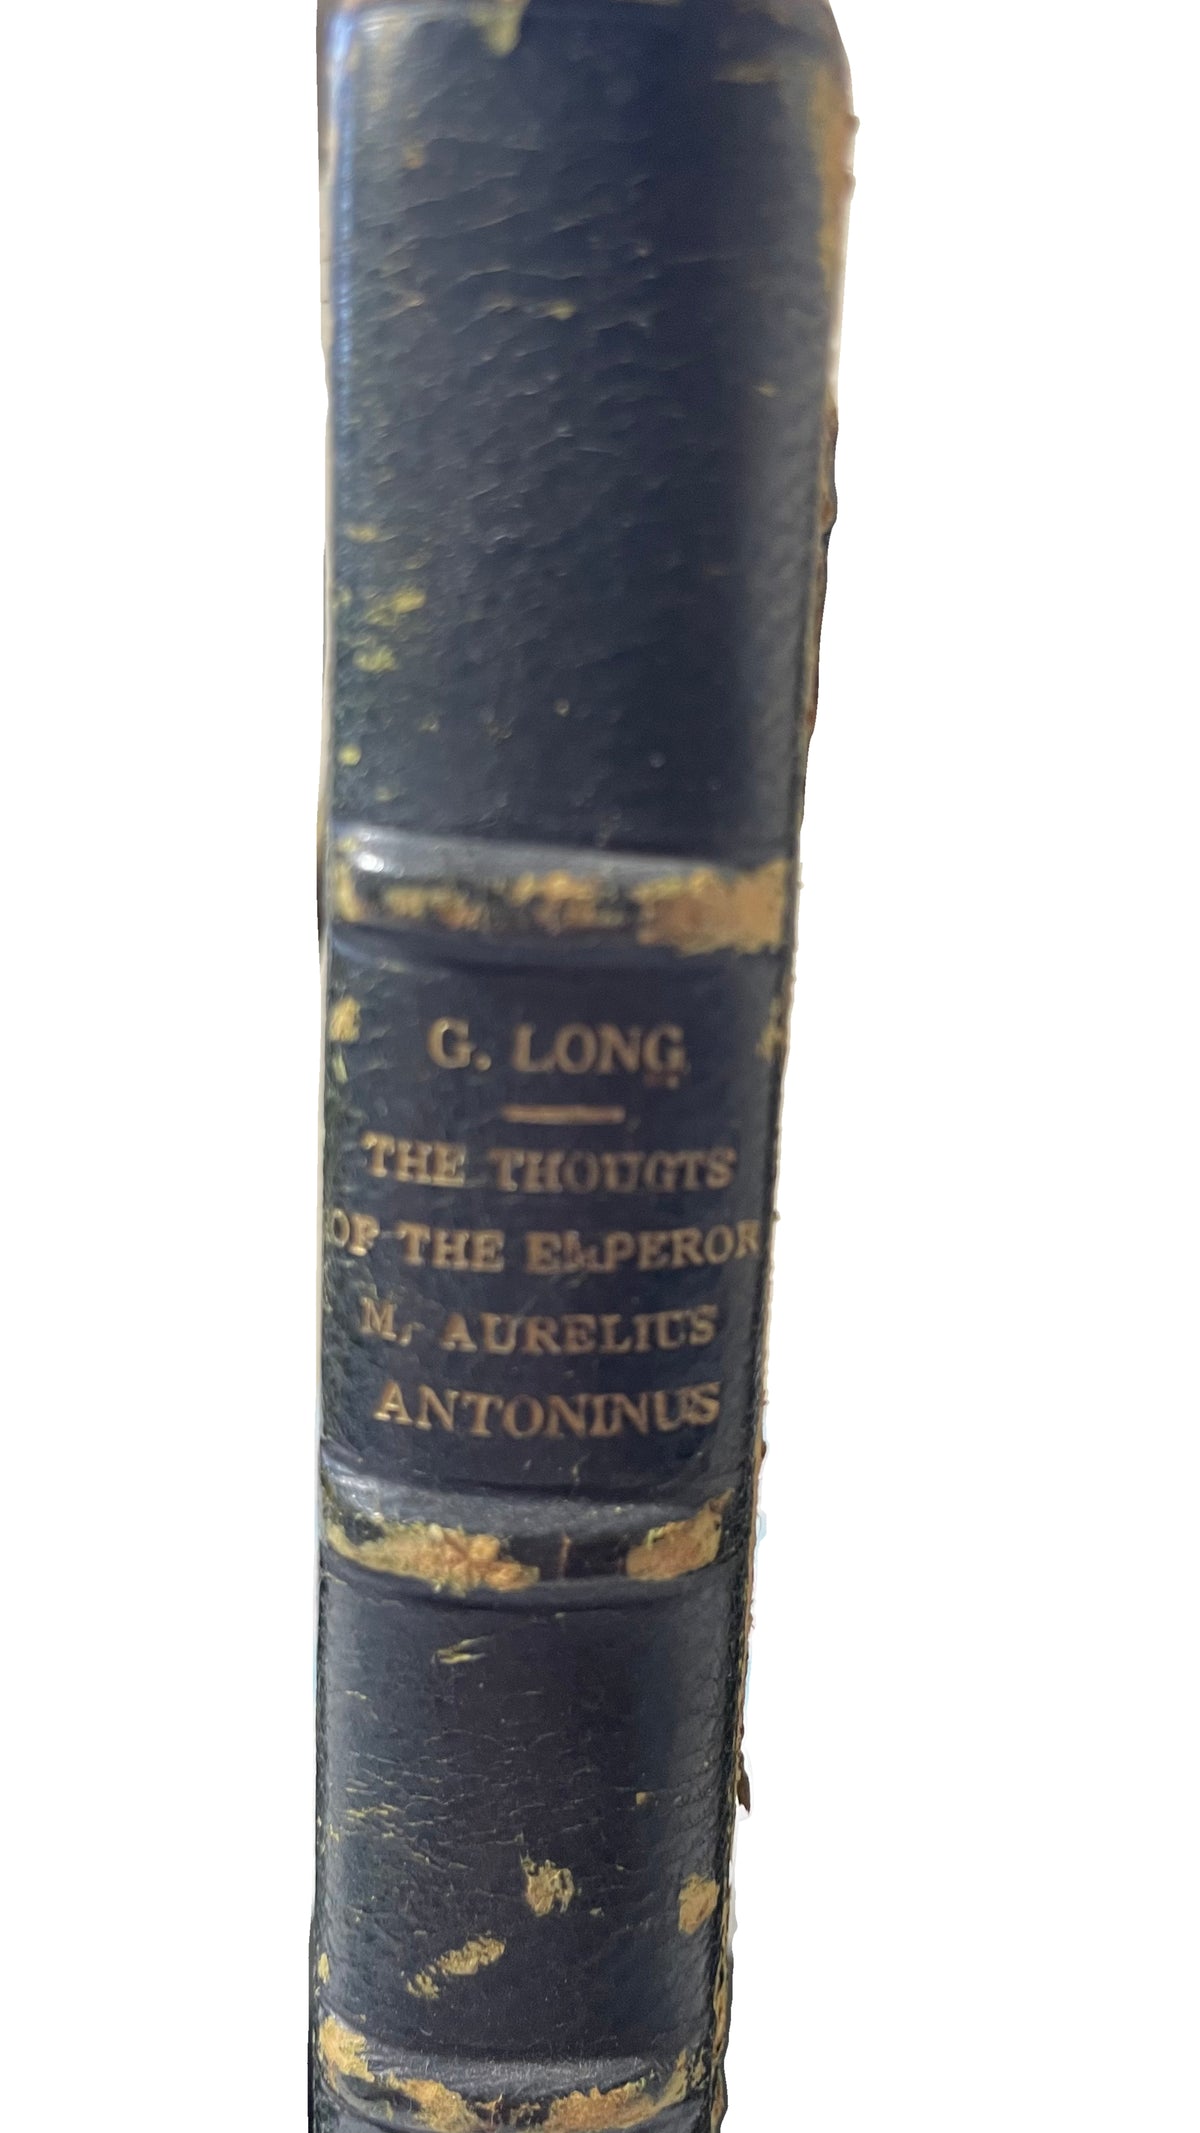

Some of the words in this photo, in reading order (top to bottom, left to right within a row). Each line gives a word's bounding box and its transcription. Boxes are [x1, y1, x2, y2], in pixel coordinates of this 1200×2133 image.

[428, 1018, 491, 1071] G.
[511, 1022, 687, 1075] LONG
[362, 1134, 466, 1187] THE
[489, 1147, 737, 1193] THOUGTS
[328, 1208, 380, 1257] OF
[395, 1222, 504, 1274] THE
[440, 1304, 719, 1355] AURELIUS
[373, 1380, 722, 1439] ANTONINUS
